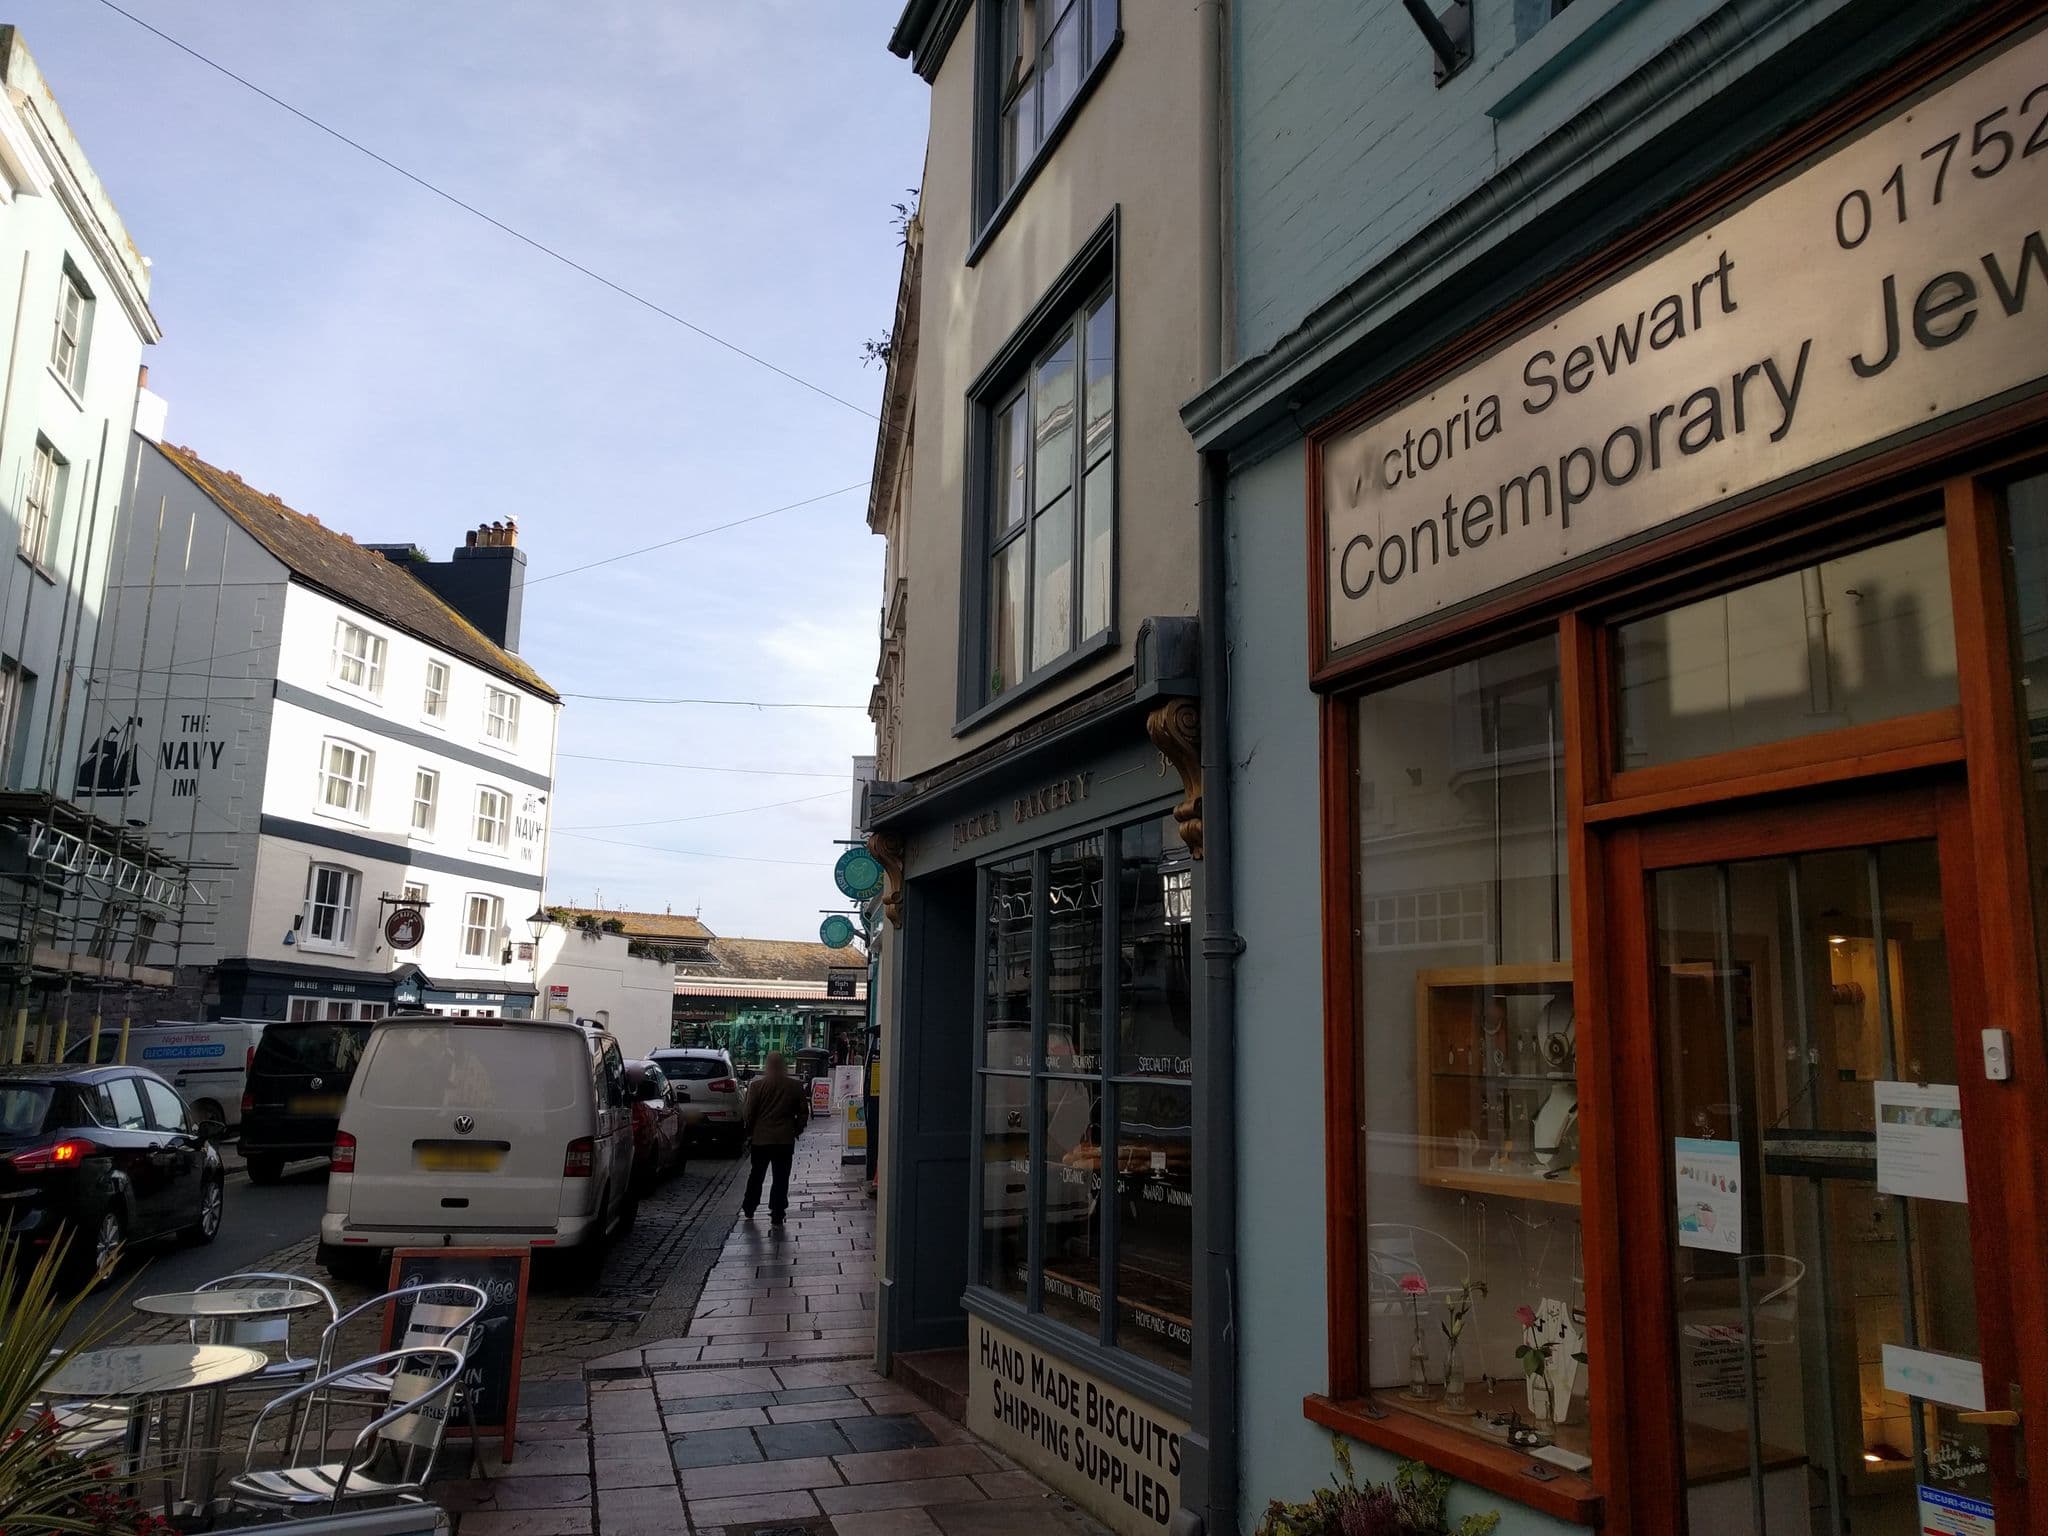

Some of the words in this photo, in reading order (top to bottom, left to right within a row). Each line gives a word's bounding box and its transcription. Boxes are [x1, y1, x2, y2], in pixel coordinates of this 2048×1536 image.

[1835, 83, 2048, 250] 01752
[1347, 393, 1501, 509] ctoria
[1521, 251, 1737, 413] Sewart
[1340, 339, 1813, 599] Contemporary
[1851, 232, 2048, 378] Jew
[181, 715, 211, 734] THE
[160, 741, 226, 770] NAVY
[172, 778, 199, 797] INN
[1013, 772, 1091, 824] BAKERY
[515, 815, 542, 843] NAVY
[1168, 1323, 1191, 1344] CAKES
[980, 1328, 1024, 1386] HAND
[1031, 1354, 1080, 1418] MADE
[1086, 1382, 1181, 1477] BISCUITS
[993, 1379, 1069, 1462] SHIPPING
[1075, 1426, 1171, 1525] SUPPLIED
[1921, 1490, 1994, 1516] SECURI-GUARD
